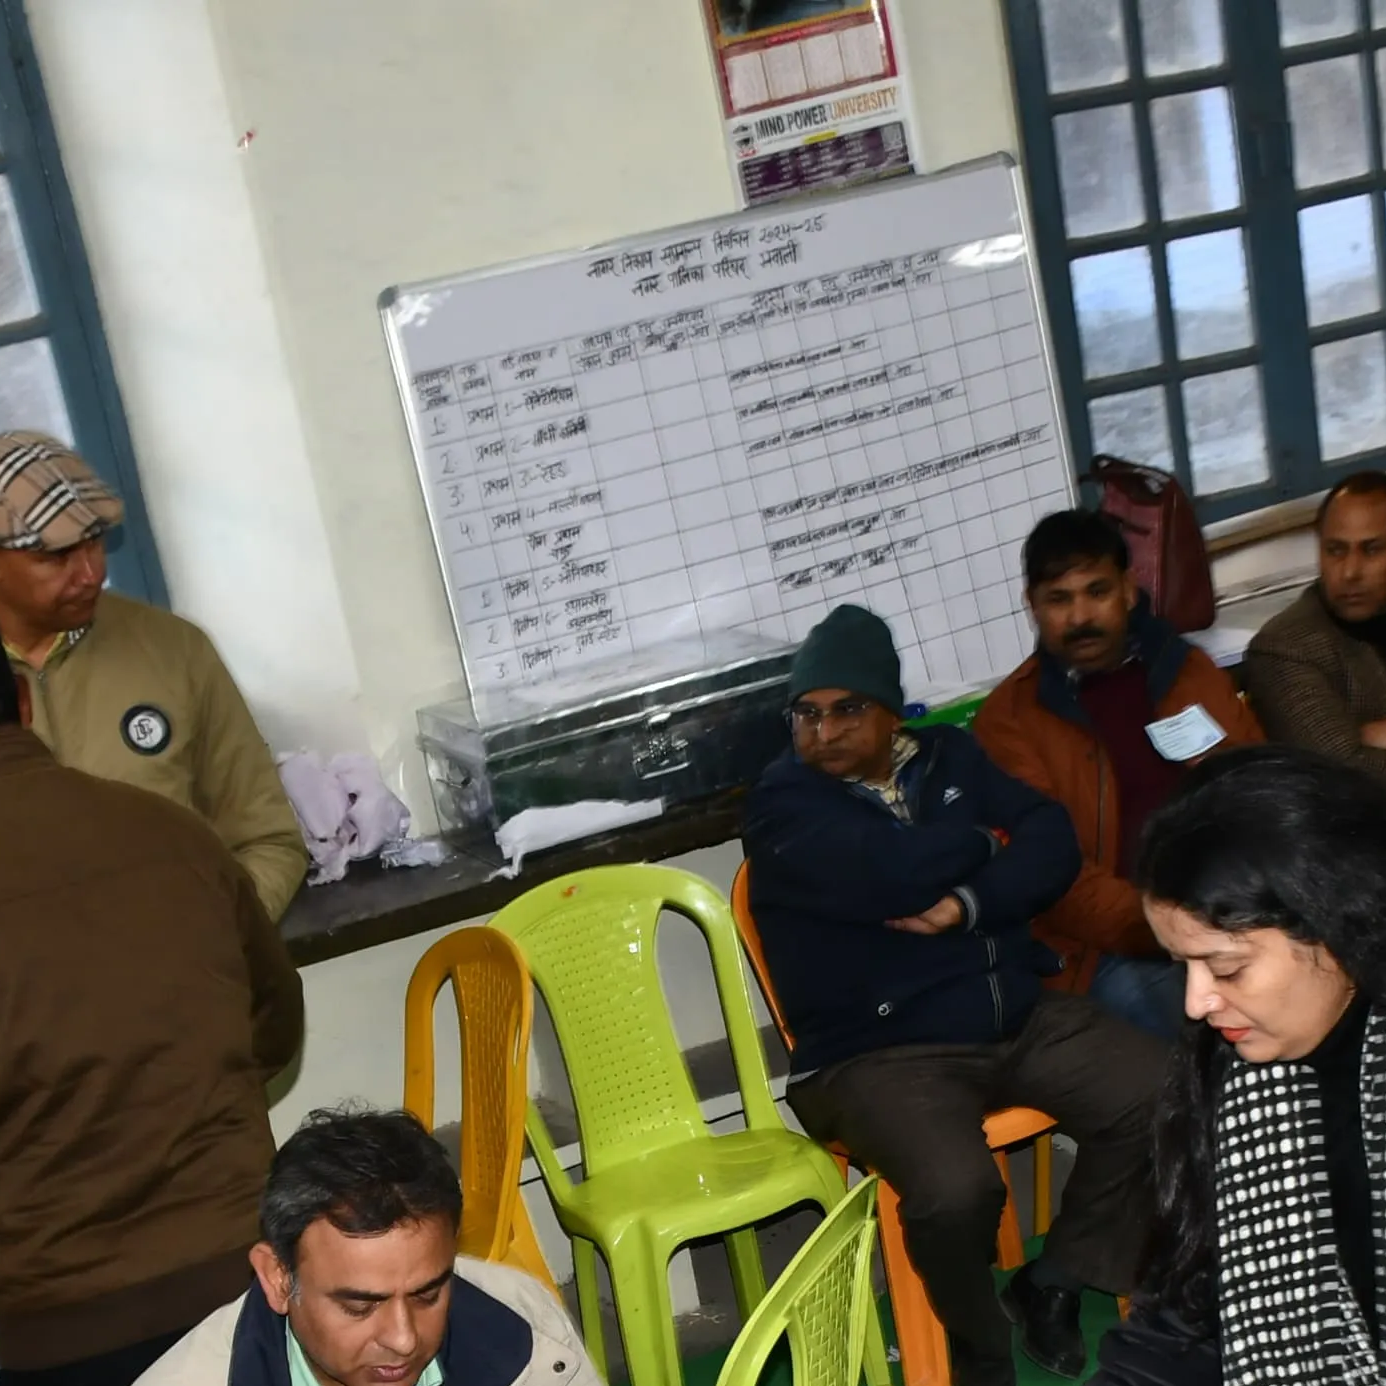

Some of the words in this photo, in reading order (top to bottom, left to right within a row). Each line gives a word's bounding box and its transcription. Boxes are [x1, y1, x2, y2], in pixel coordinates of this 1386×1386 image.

[754, 118, 785, 140] MIND
[786, 104, 828, 131] POWER
[830, 87, 898, 120] UNIVERSITY
[668, 262, 705, 288] पालिका
